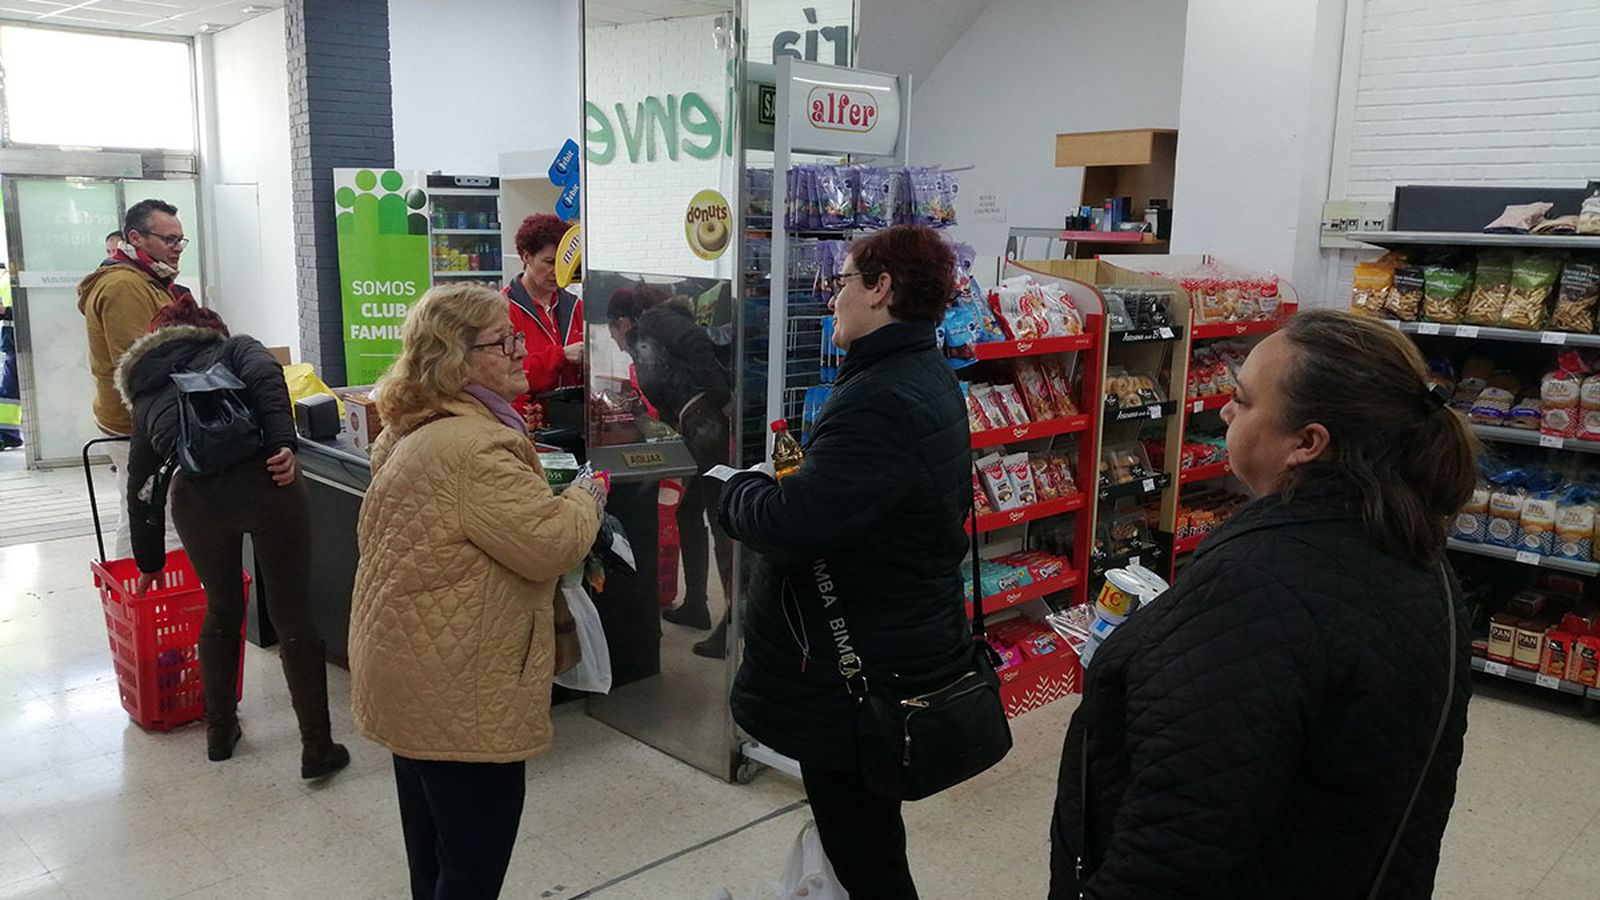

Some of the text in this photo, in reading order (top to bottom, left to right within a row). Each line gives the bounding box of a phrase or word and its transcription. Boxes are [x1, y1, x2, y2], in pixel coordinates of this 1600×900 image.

[811, 92, 875, 127] alfer
[686, 204, 728, 224] donuts
[351, 280, 416, 296] SOMOS
[361, 303, 407, 318] CLUB
[1098, 585, 1124, 608] 1€
[812, 558, 861, 680] IMBA BIMBA
[1492, 627, 1511, 638] PAN
[1519, 633, 1538, 645] PAN
